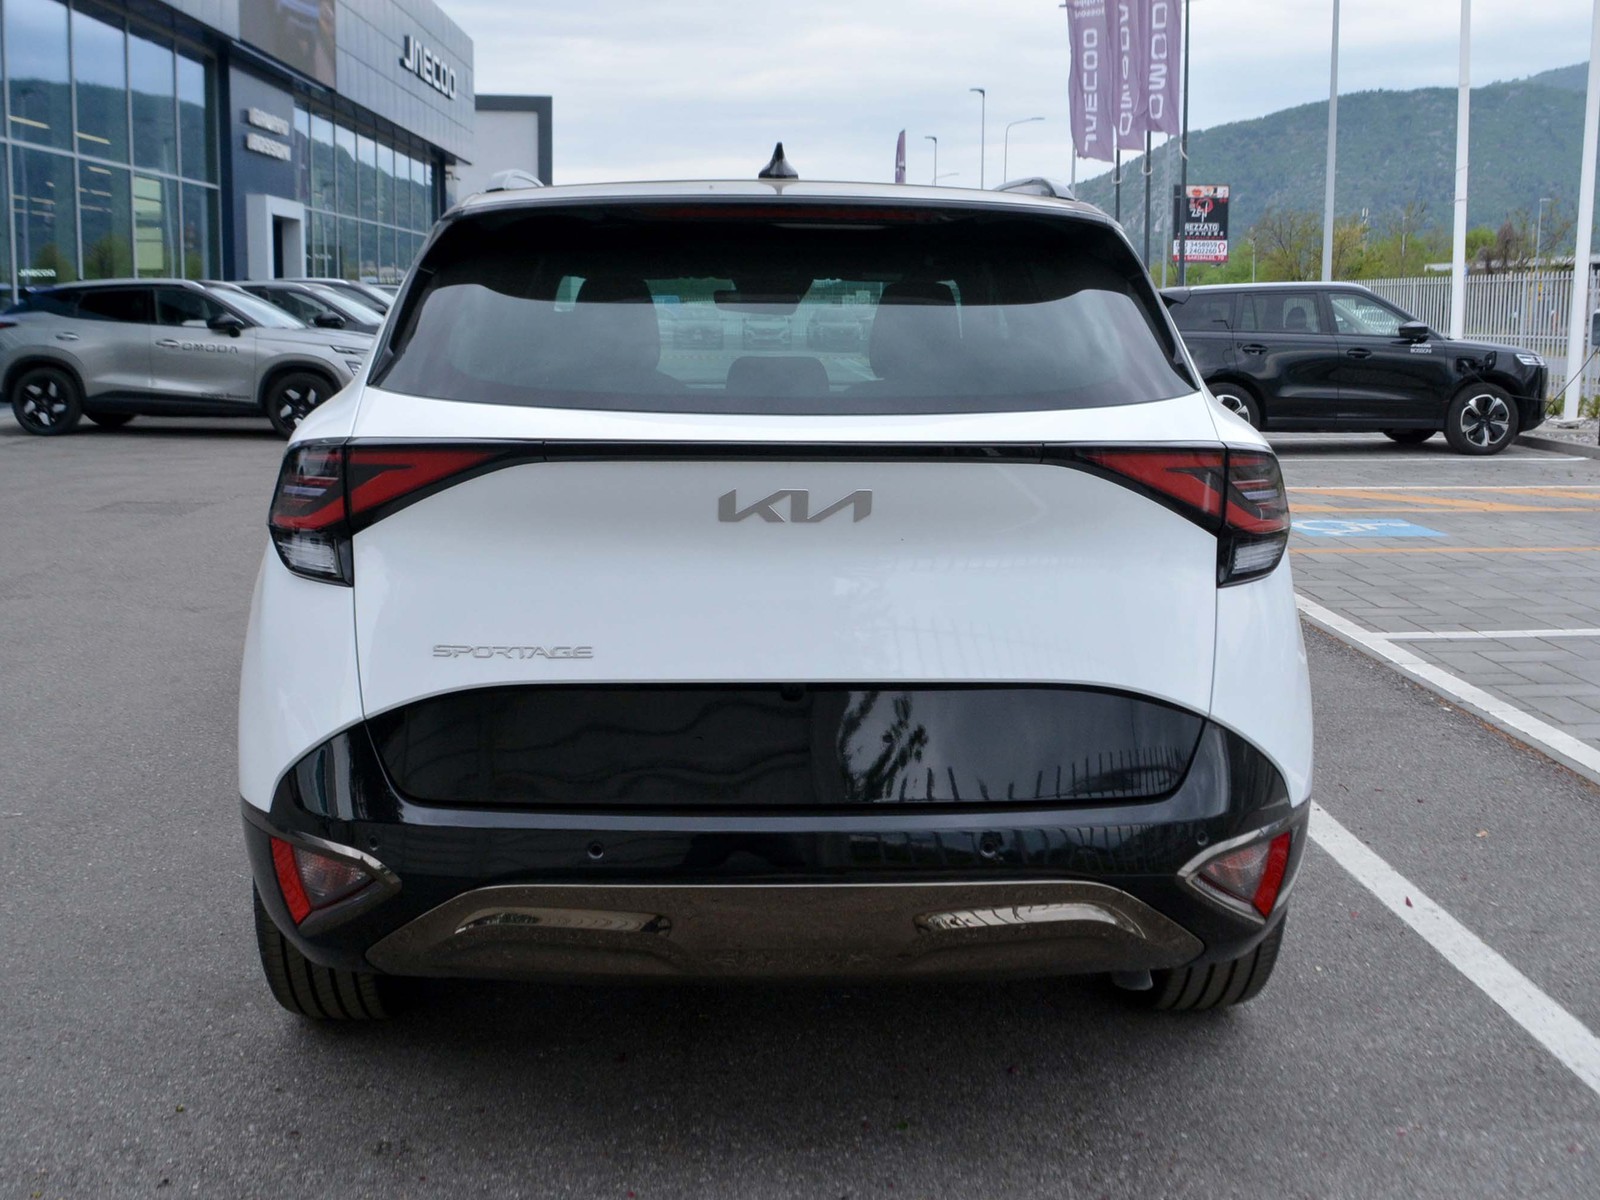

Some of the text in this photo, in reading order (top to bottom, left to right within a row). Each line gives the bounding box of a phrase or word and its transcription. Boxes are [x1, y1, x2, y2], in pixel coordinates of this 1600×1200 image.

[400, 35, 457, 100] JAECOO
[182, 343, 238, 354] OMODA
[718, 487, 873, 523] KIA
[432, 644, 594, 659] SPORTAGE
